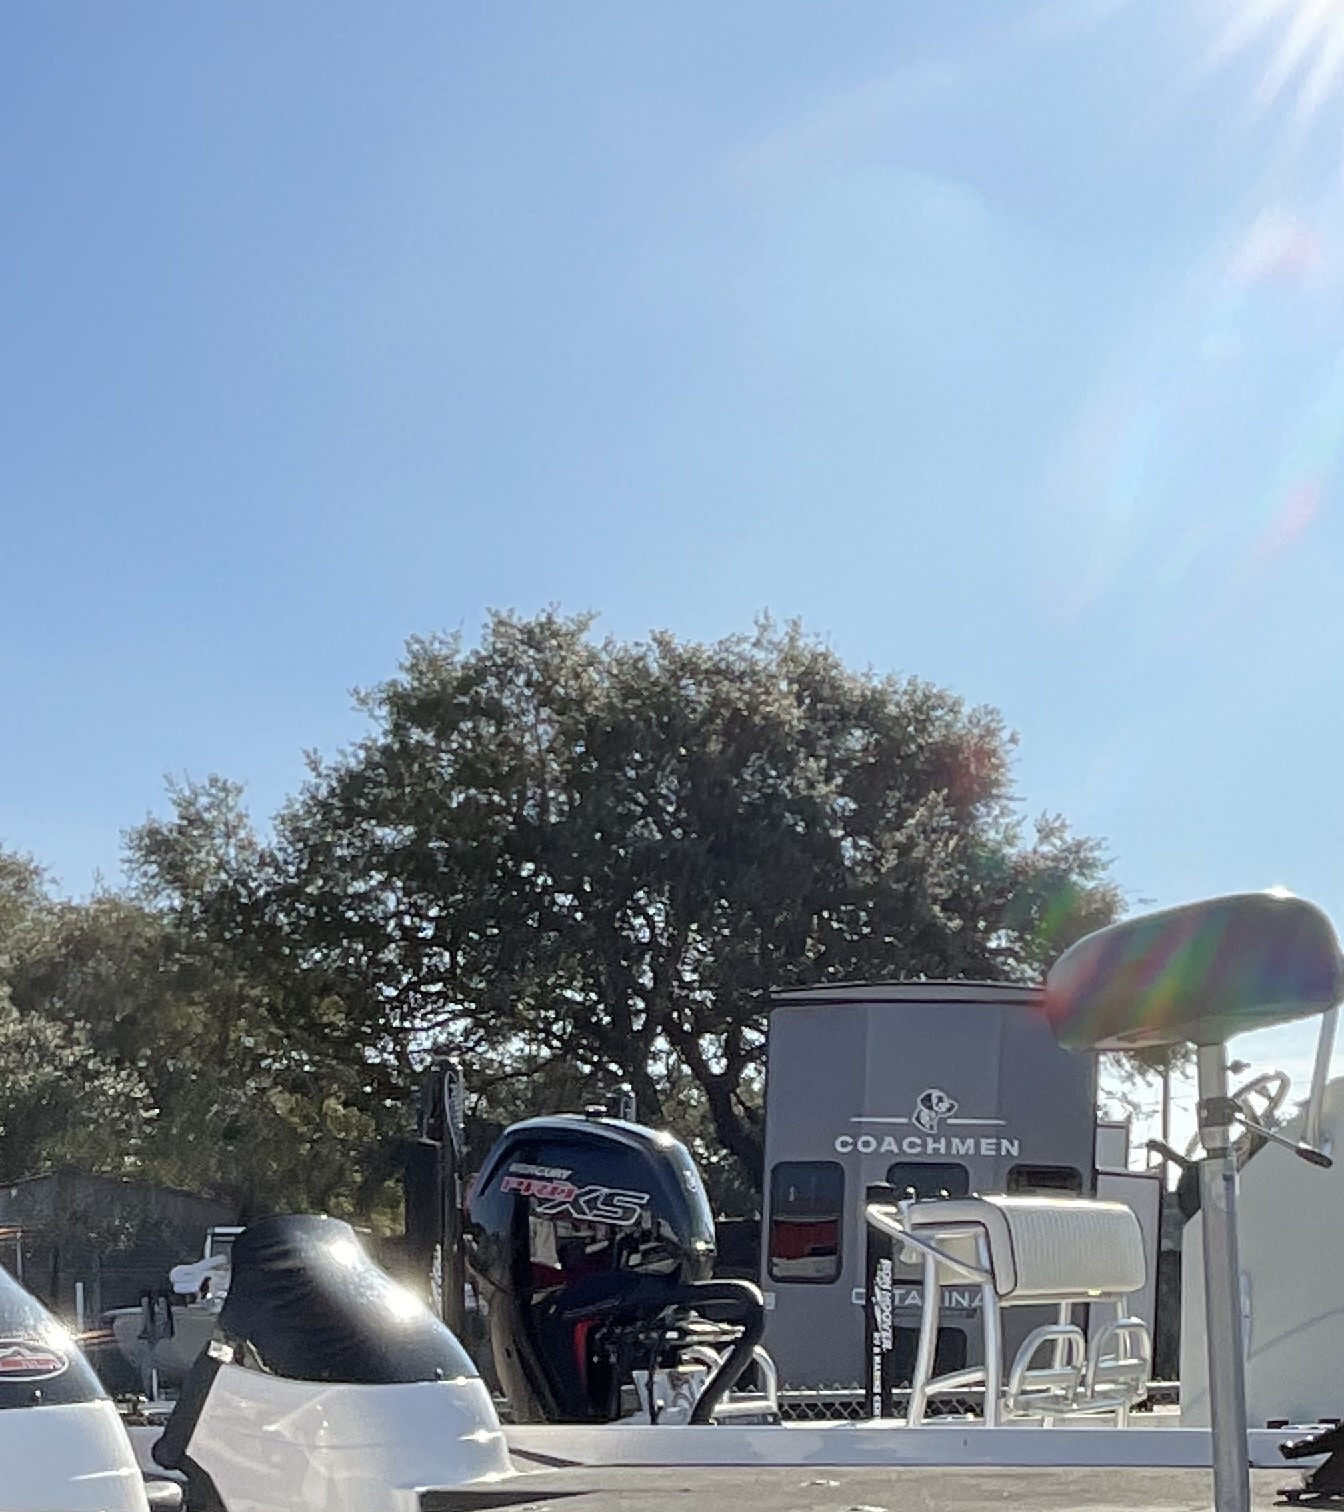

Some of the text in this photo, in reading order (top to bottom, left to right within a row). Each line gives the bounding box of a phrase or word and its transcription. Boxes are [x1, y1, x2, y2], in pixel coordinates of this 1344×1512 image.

[834, 1136, 1020, 1157] COACHMEN
[535, 1185, 651, 1226] XS
[851, 1287, 984, 1308] CTAINA
